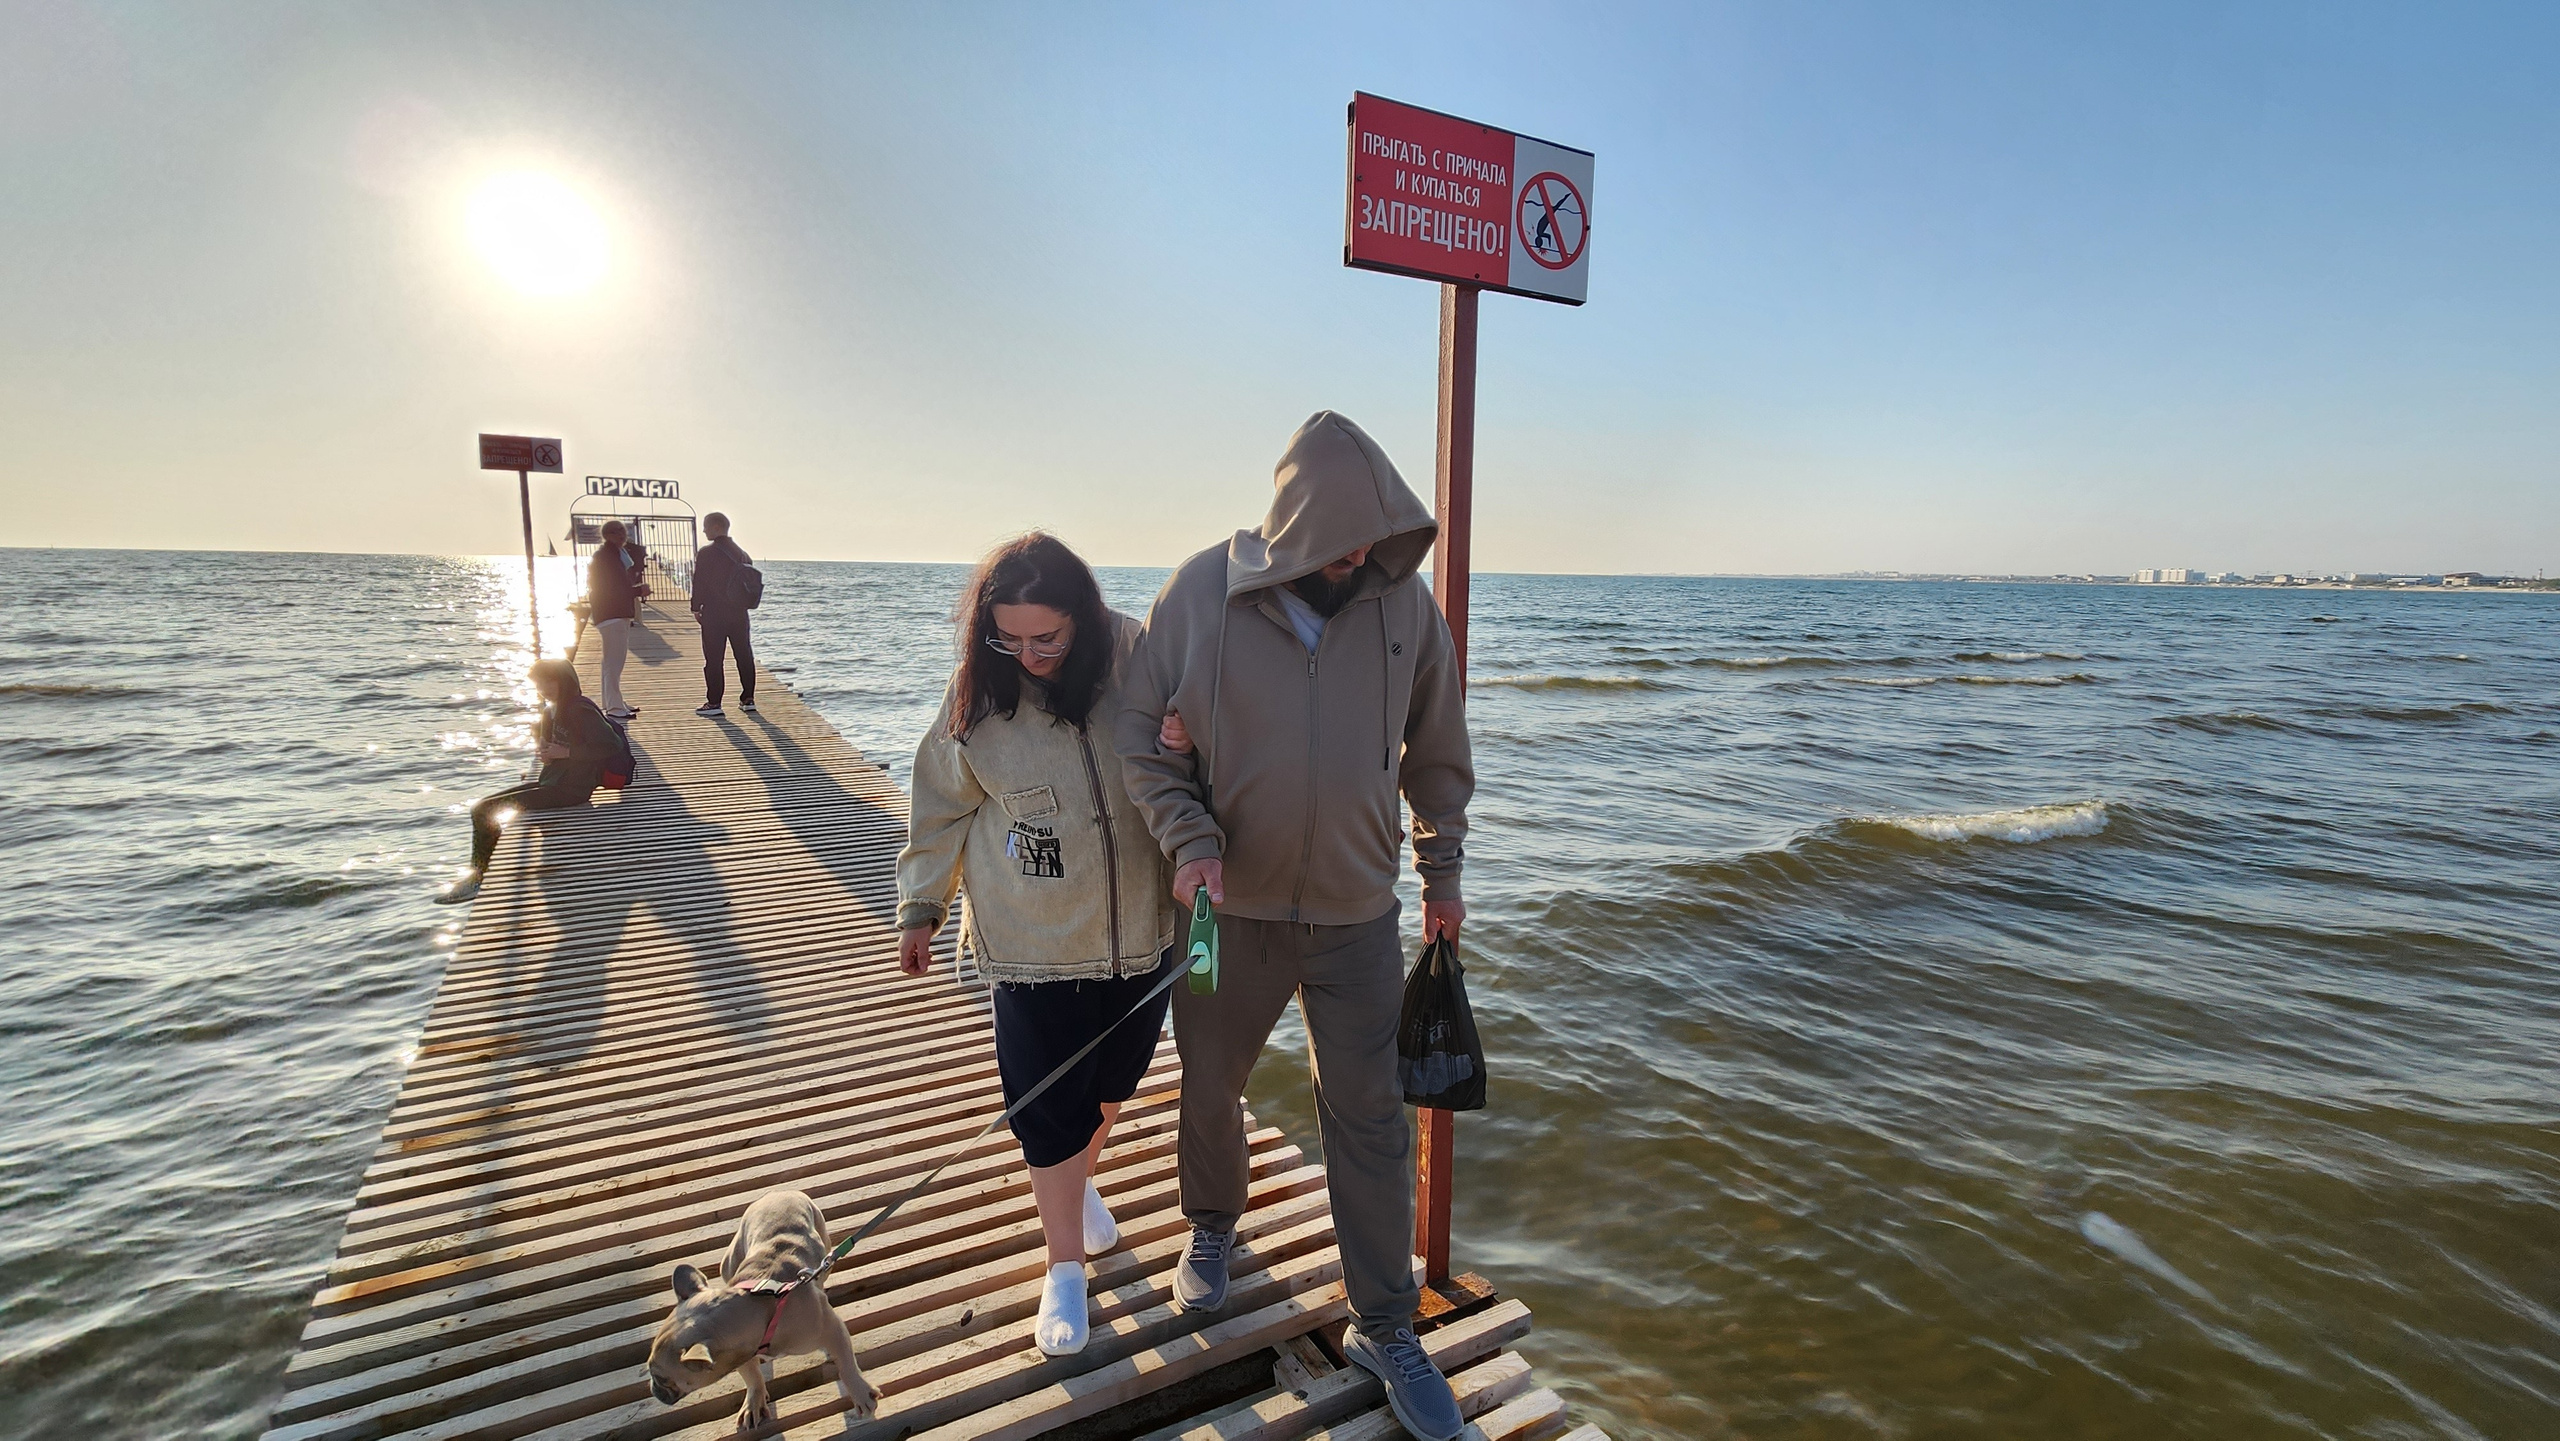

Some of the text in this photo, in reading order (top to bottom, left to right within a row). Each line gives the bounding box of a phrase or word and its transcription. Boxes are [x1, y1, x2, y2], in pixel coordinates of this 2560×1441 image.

[1362, 131, 1507, 187] ПРЫГАТЬ С ПРИЧАЛА
[1395, 169, 1481, 208] И КУПАТЬСЯ
[1359, 194, 1506, 257] ЗАПРЕЩЕНО!
[587, 477, 678, 499] ПРИЧАЛ
